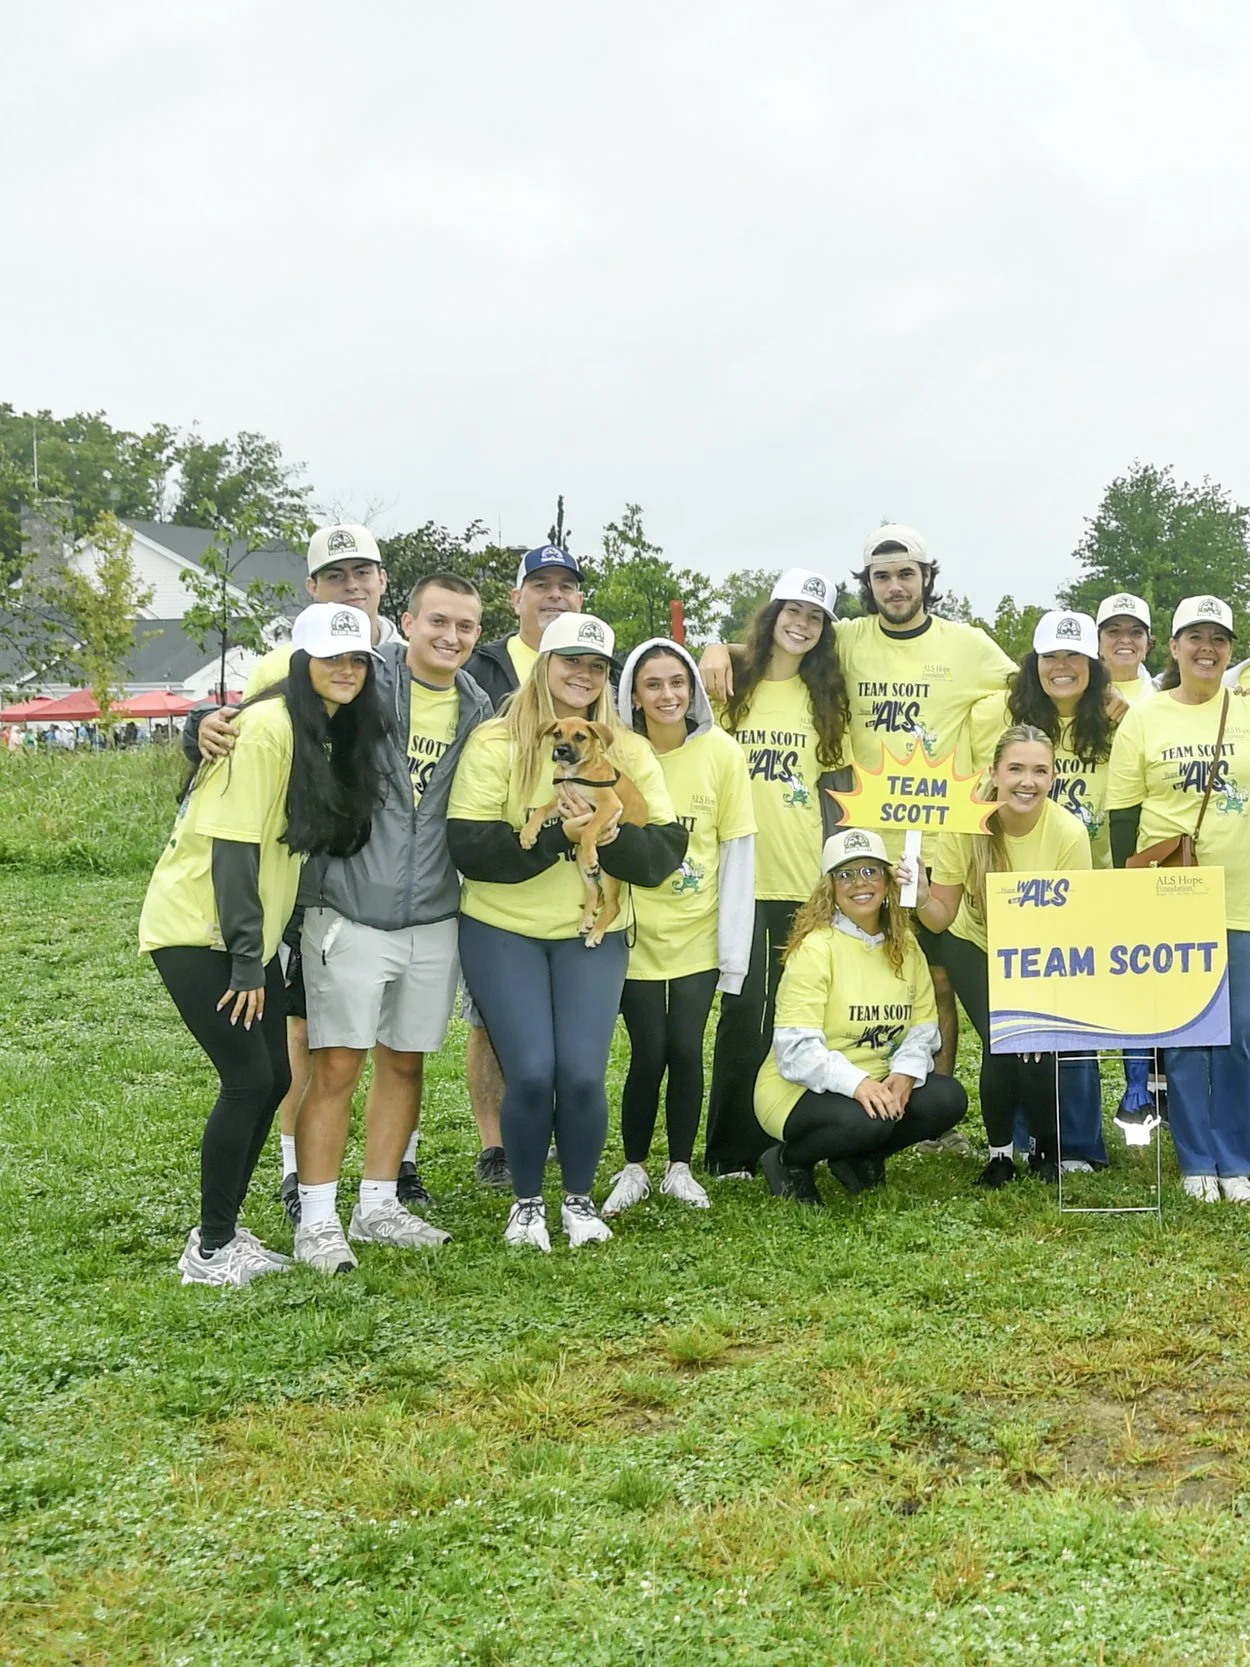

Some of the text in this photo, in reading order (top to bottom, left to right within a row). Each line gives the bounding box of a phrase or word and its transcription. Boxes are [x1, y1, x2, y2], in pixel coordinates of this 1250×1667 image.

[858, 682, 930, 698] TEAM SCOTT
[736, 730, 807, 748] TEAM SCOTT
[1161, 745, 1194, 761] TEAM
[887, 776, 947, 798] TEAM
[880, 803, 949, 825] SCOTT
[1157, 875, 1203, 887] ALS Hope
[997, 942, 1218, 979] TEAM SCOTT
[849, 1004, 912, 1021] TEAM SCOTT
